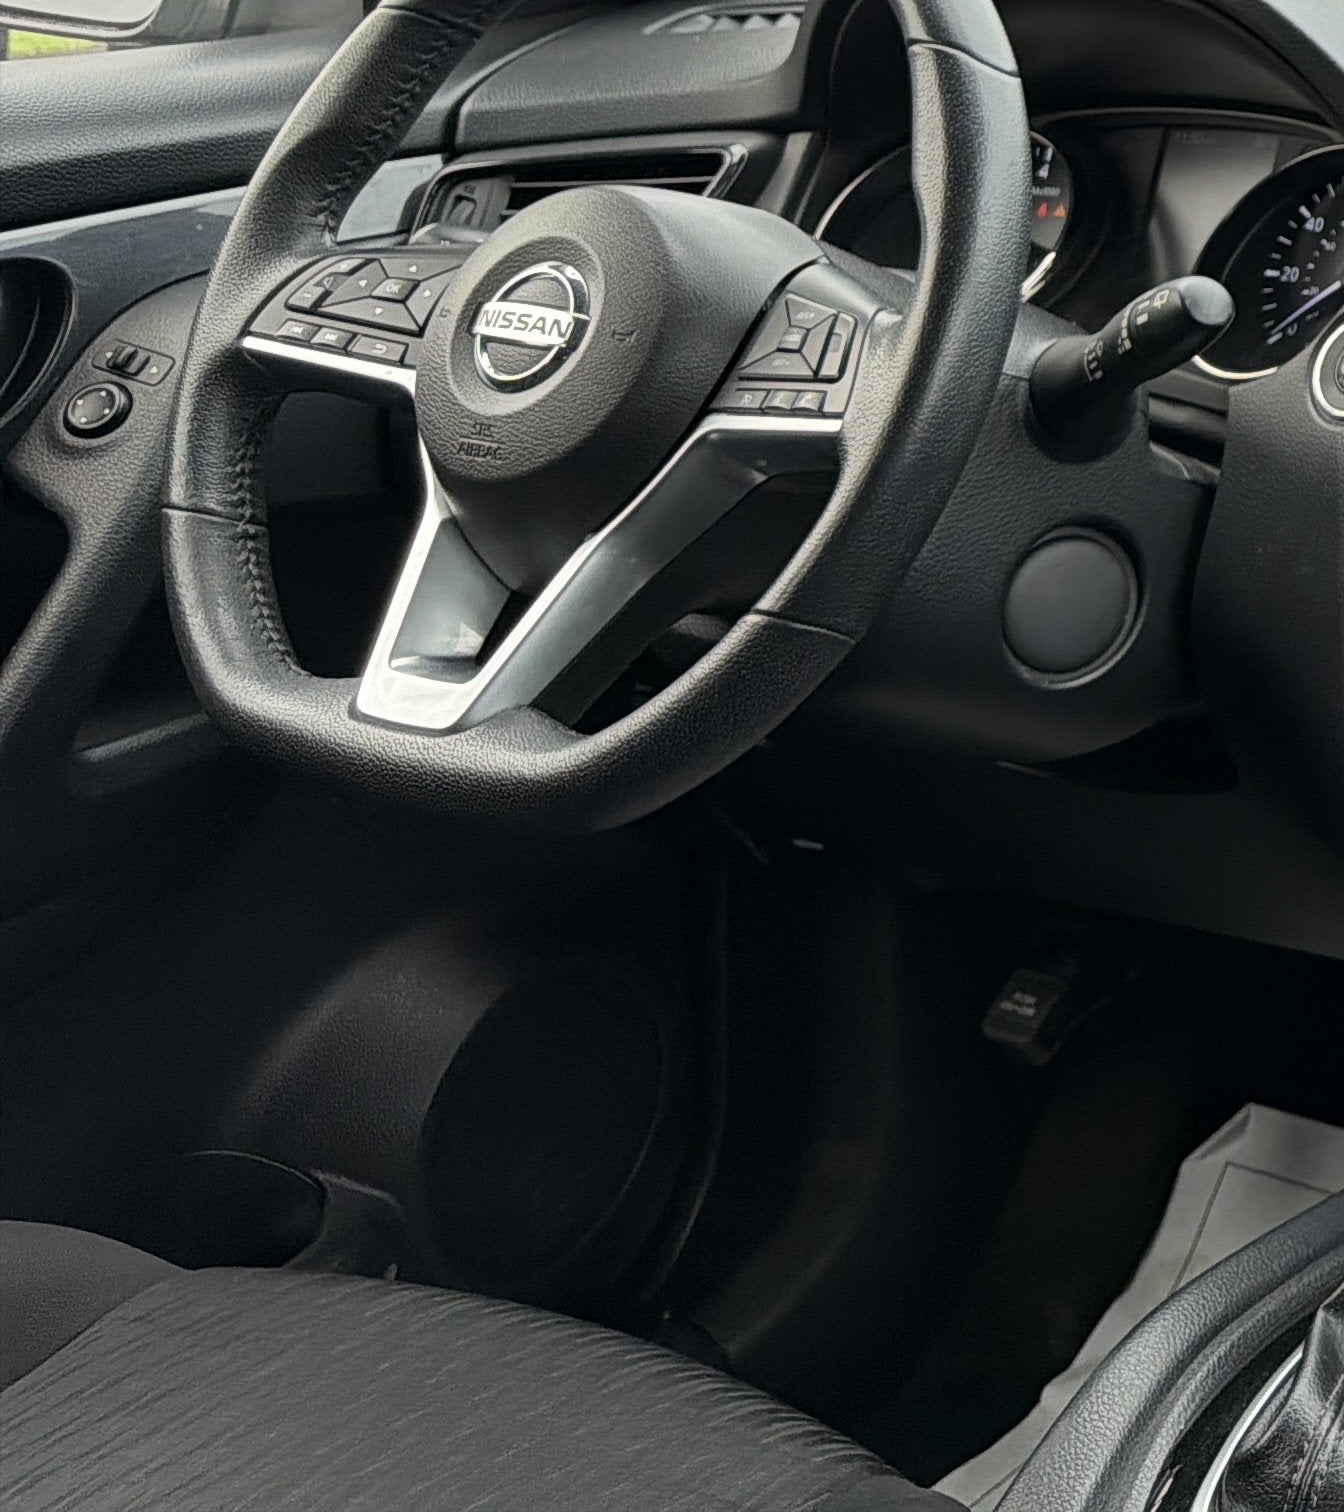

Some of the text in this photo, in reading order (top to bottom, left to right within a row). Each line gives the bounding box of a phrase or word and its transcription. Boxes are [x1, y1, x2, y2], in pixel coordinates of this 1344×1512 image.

[1303, 216, 1325, 233] 40
[1280, 265, 1300, 283] 20
[479, 308, 574, 340] NISSAN
